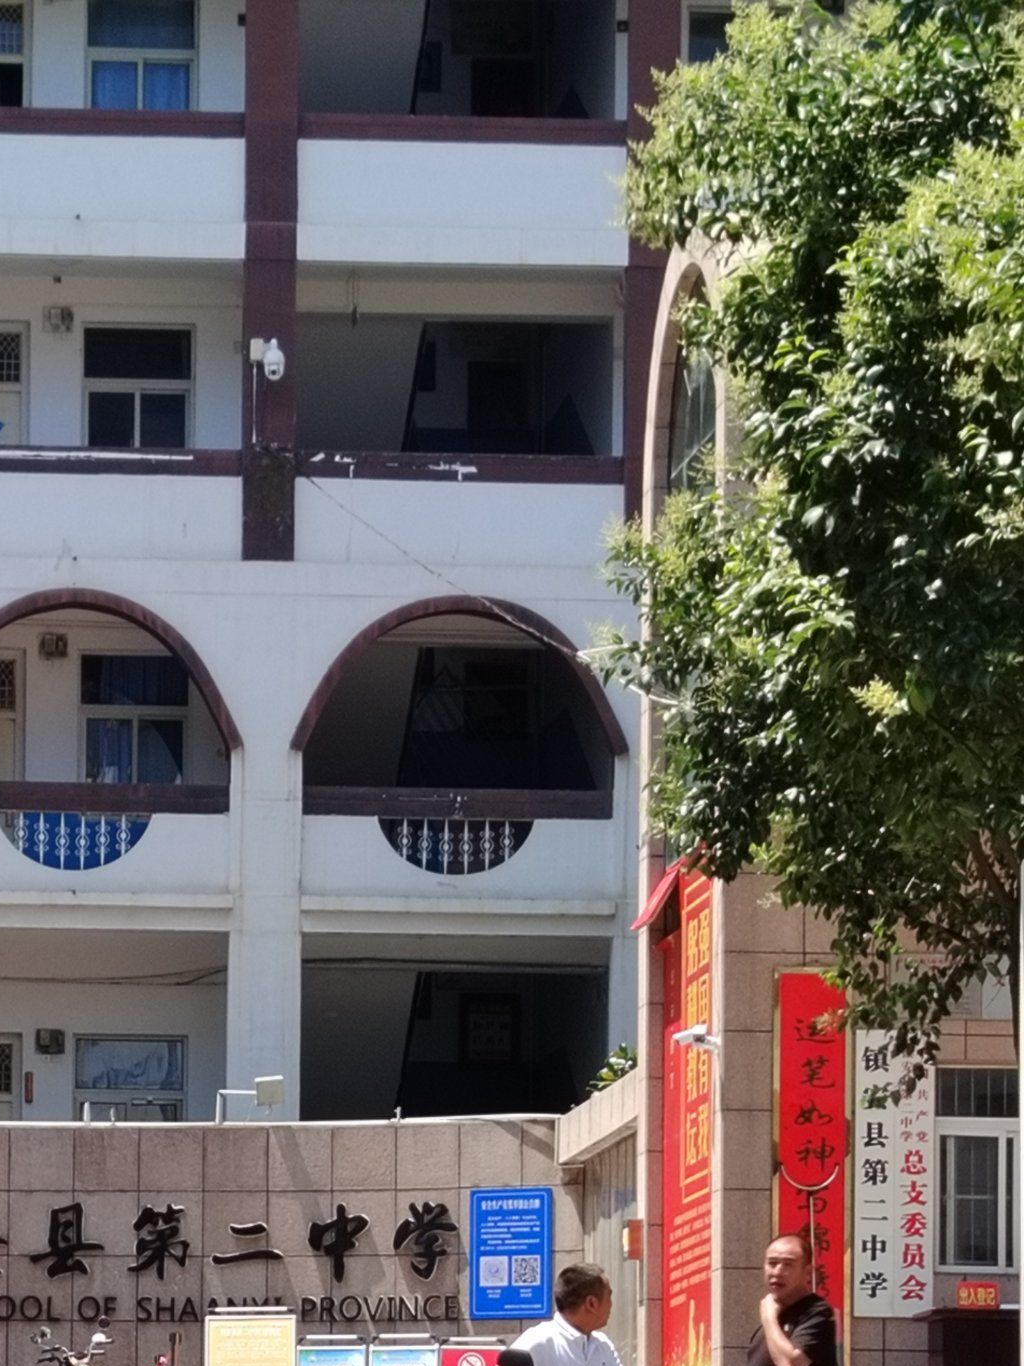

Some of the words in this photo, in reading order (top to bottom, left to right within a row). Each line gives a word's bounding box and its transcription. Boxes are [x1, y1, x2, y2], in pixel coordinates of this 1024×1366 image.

[697, 906, 710, 1159] 强国有我
[859, 1045, 890, 1299] 镇安县第二中学
[899, 1149, 928, 1301] 总支委员会
[78, 1295, 117, 1321] OF
[301, 1295, 458, 1322] PROVINCE
[958, 1286, 996, 1306] 出入登记
